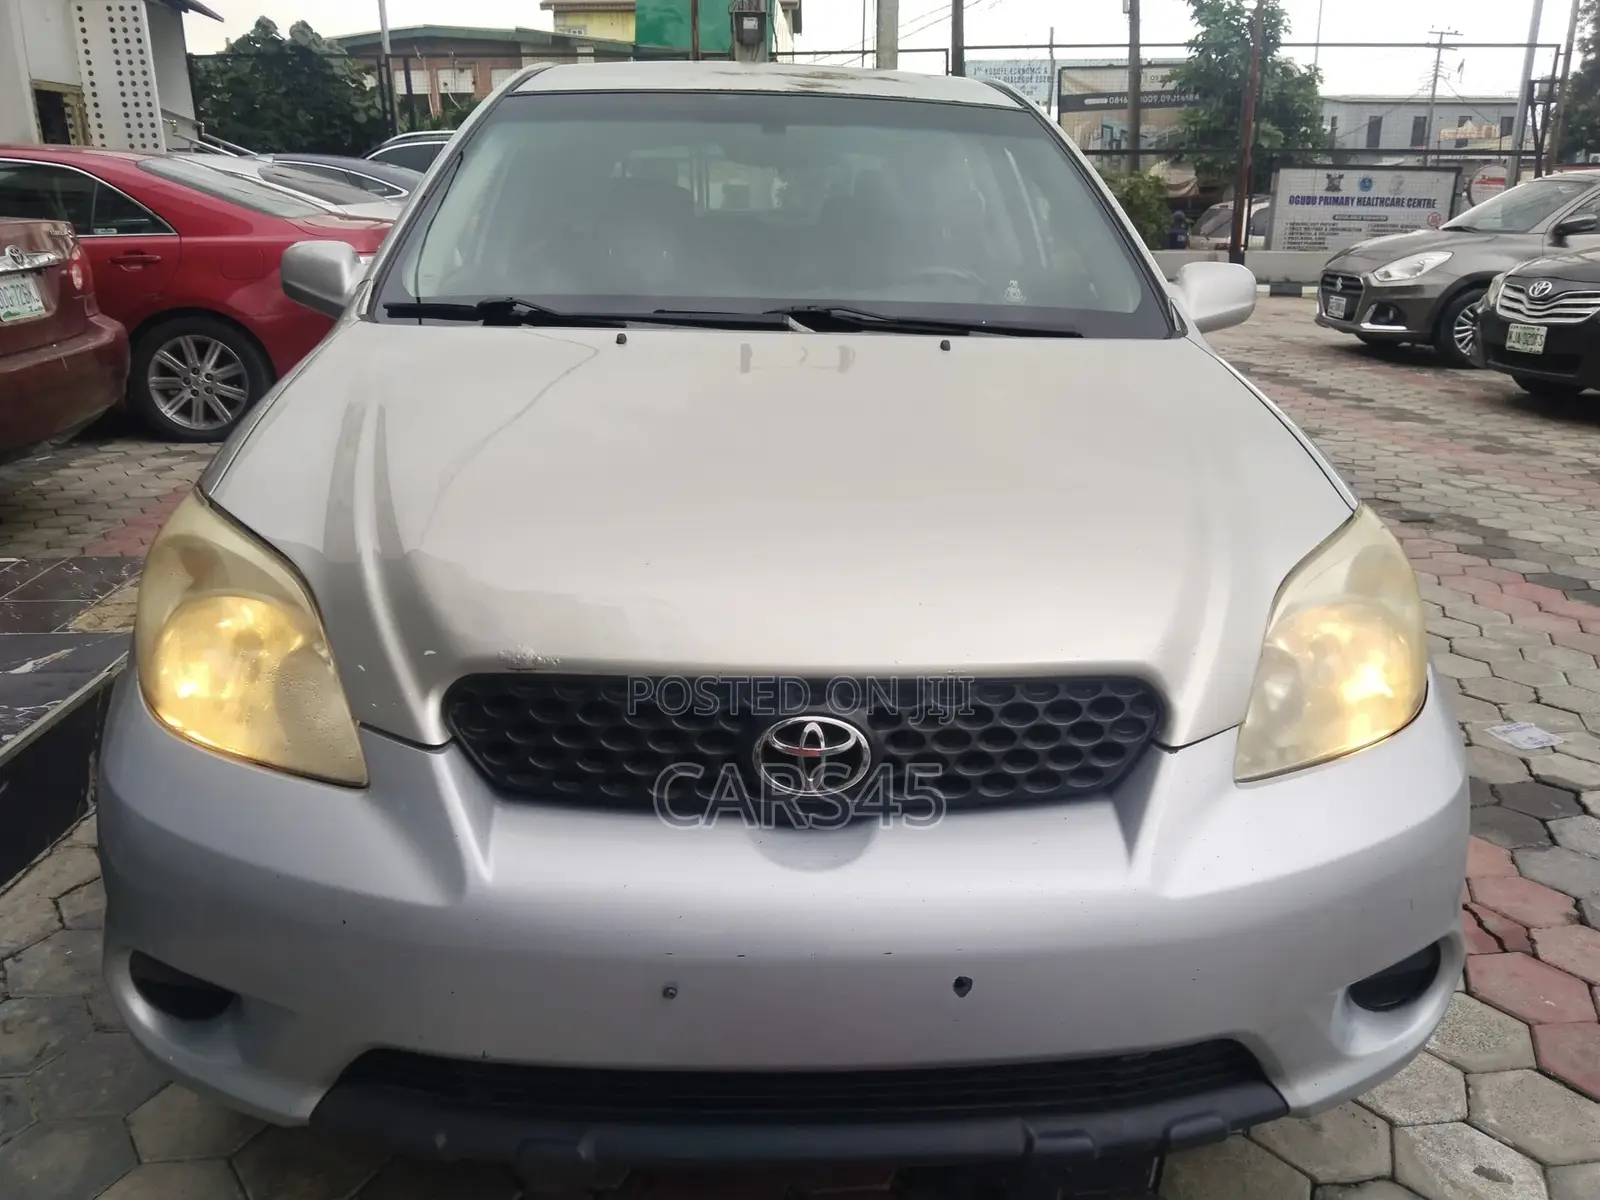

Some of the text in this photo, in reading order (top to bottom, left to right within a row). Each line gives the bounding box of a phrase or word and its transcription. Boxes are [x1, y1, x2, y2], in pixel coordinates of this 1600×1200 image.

[1288, 195, 1437, 209] OGUDU PRIMARY HEALTHCARE CENTRE
